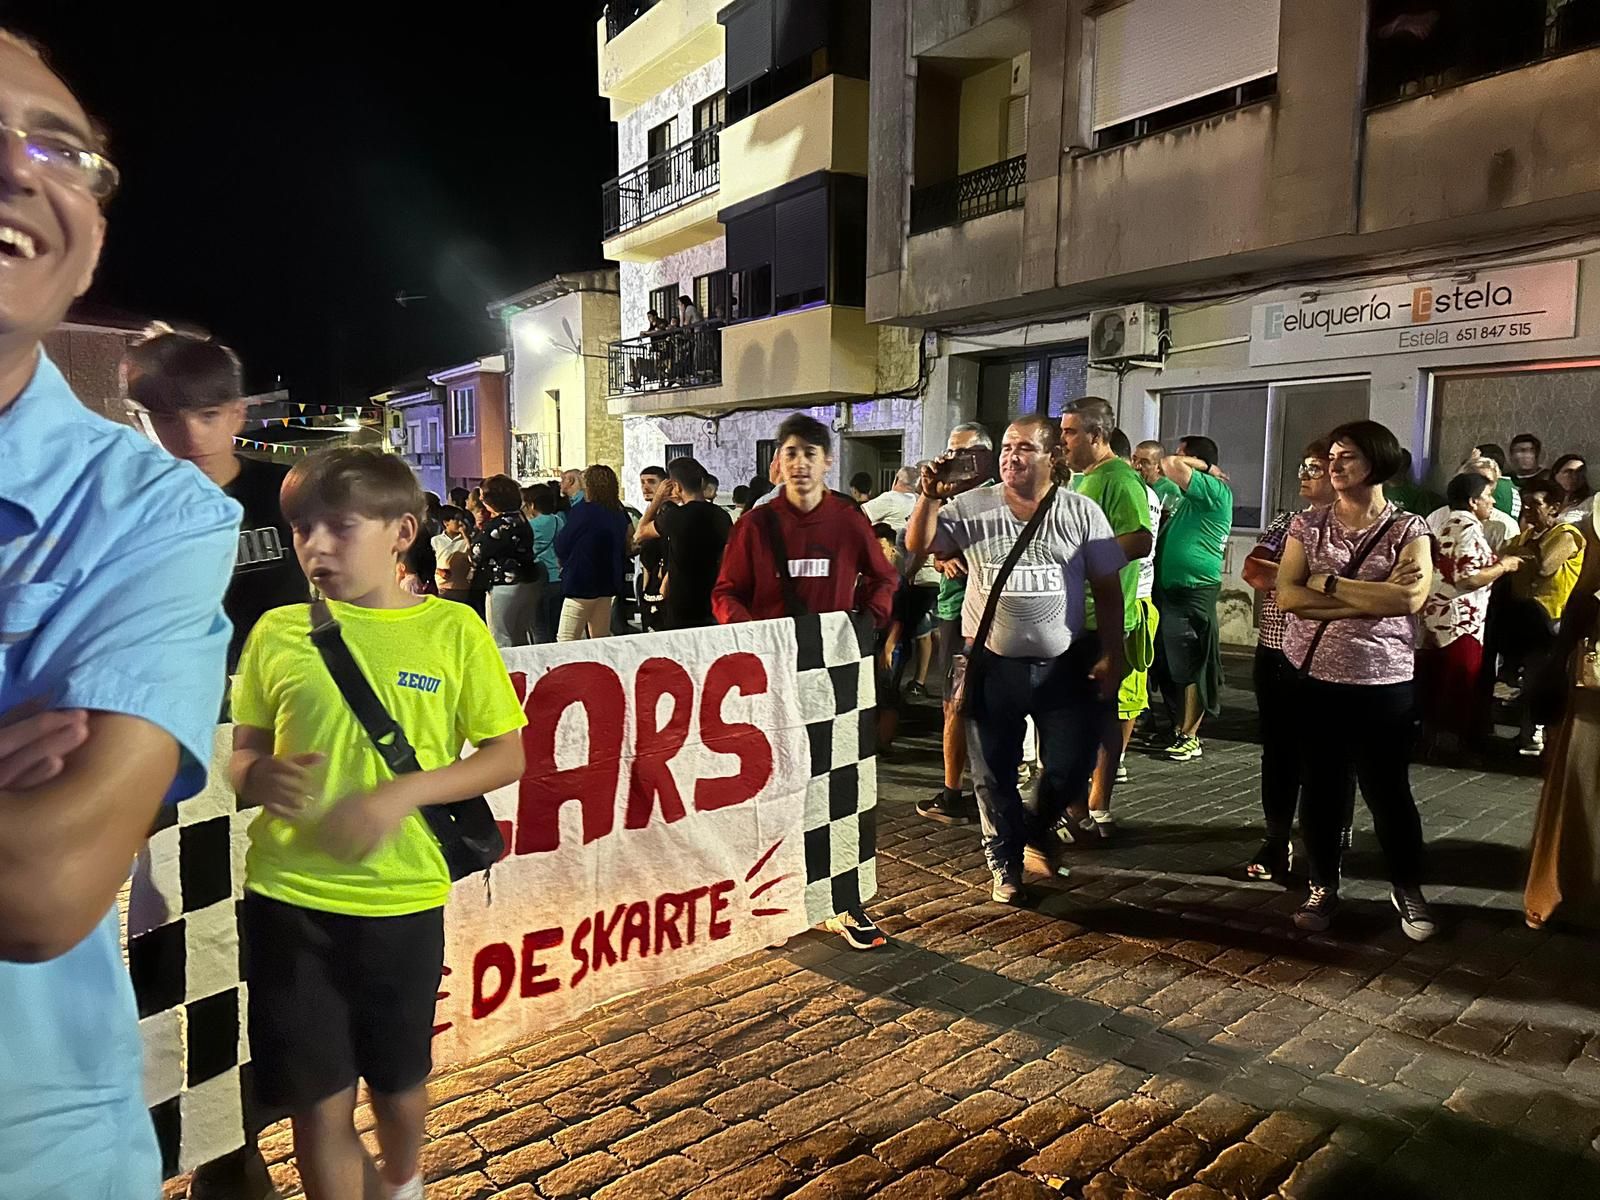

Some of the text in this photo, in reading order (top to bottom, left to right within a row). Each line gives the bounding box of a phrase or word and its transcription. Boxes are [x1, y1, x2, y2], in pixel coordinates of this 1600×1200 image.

[1270, 294, 1391, 333] Peluquería
[1419, 281, 1512, 316] Estela
[1398, 322, 1532, 348] Estela 651 847 515
[397, 670, 442, 694] ZEQUI
[496, 652, 773, 863] ARS
